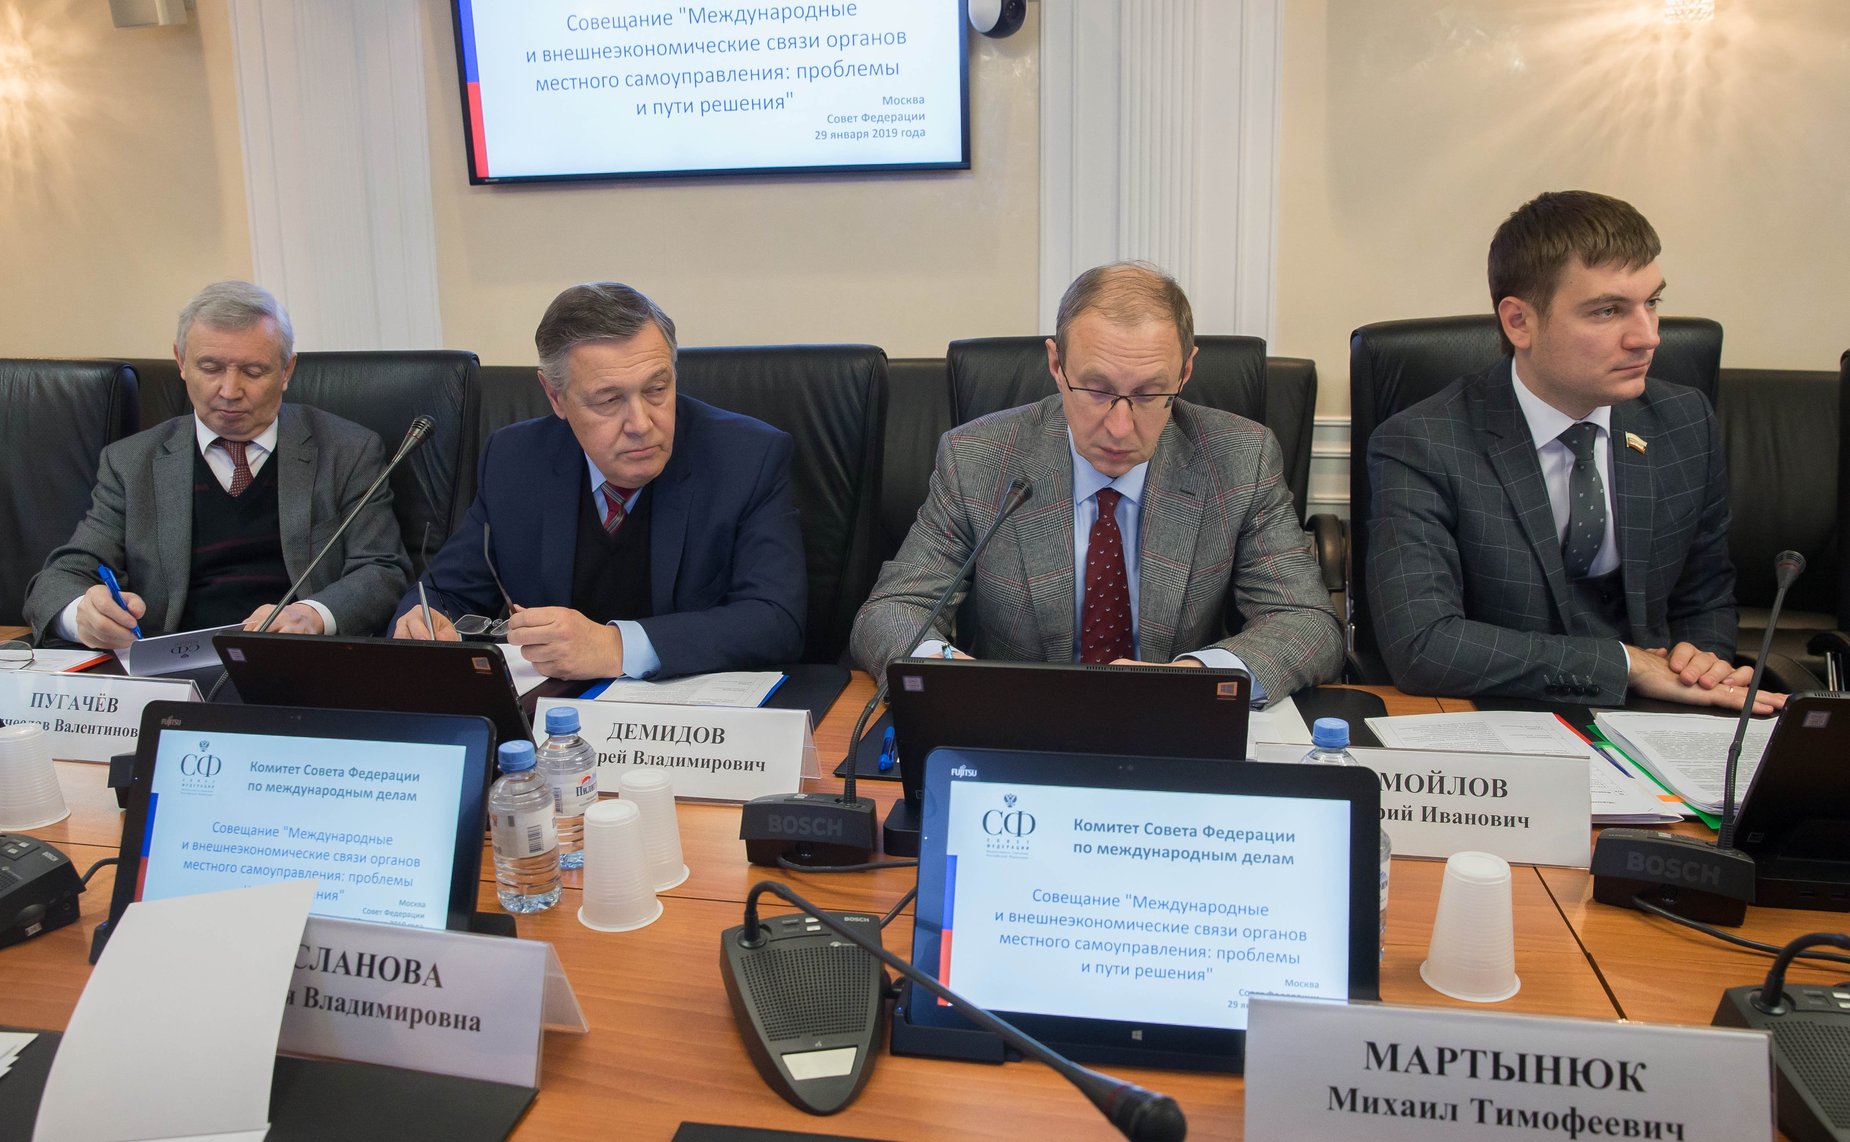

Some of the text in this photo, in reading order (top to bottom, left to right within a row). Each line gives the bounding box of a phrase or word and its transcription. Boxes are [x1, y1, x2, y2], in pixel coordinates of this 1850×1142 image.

[566, 1, 858, 33] Совещание "Международные
[526, 30, 907, 64] и внешнеэкономические связи органов
[535, 59, 900, 96] местного самоуправления: проблемы
[636, 91, 794, 120] и пути решения"
[882, 95, 925, 107] Москва
[827, 110, 926, 127] Совет Федерации
[814, 127, 926, 143] 29 января 2019 года
[30, 692, 120, 714] ПУГАЧЁВ
[54, 718, 138, 738] Валентинов
[606, 722, 726, 747] ДЕМИДОВ
[180, 753, 222, 778] СФ
[250, 760, 420, 785] Комитет Совета Федерации
[596, 750, 766, 773] рей Владимирович
[951, 764, 977, 778] FUJITSU
[248, 782, 418, 803] по международным делам
[1379, 769, 1508, 798] МОЙЛОВ
[767, 813, 843, 836] BOSCH
[982, 809, 1036, 838] СФ
[1073, 817, 1296, 844] Комитет Совета Федерации
[1421, 805, 1530, 829] Иванович
[212, 820, 393, 848] Совещание "Международные
[182, 839, 421, 872] и внешнеэкономические связи органов
[1073, 842, 1295, 865] по международным делам
[183, 860, 413, 889] местного самоуправления: проблемы
[1627, 851, 1721, 885] BOSCH
[1032, 888, 1270, 918] Совещание "Международные
[994, 908, 1308, 943] и внешнеэкономические связи органов
[999, 932, 1301, 966] местного самоуправления: проблемы
[292, 943, 443, 989] СЛАНОВА
[1081, 961, 1214, 984] и пути решения"
[1285, 978, 1319, 988] Москва
[303, 985, 482, 1033] Владимировна
[1228, 999, 1238, 1007] 29
[1363, 1040, 1647, 1093] МАРТЫНЮК
[1326, 1084, 1686, 1142] Михаил Тимофеевич
